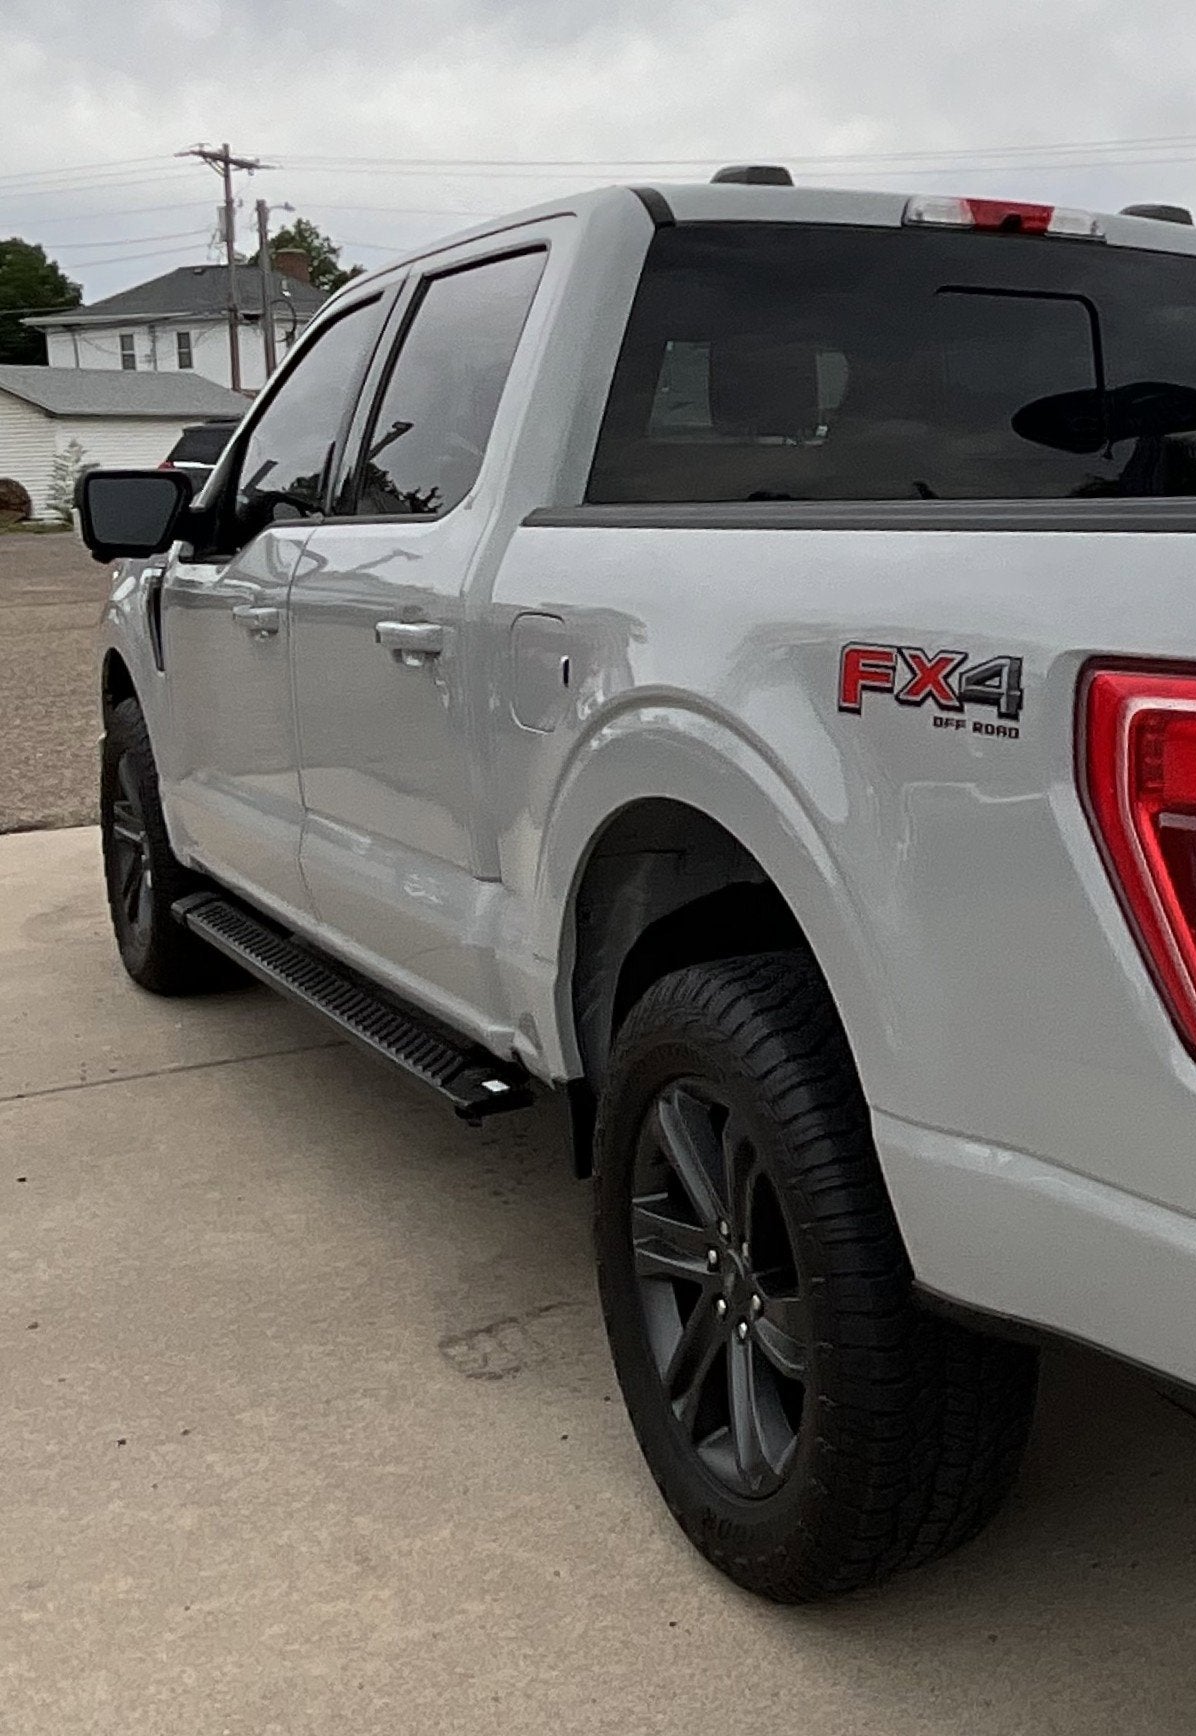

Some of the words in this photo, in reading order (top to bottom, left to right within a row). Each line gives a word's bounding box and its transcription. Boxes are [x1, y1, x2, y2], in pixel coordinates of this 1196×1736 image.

[837, 641, 1024, 722] FX4
[933, 715, 967, 731] OFF
[972, 720, 1020, 740] ROAD
